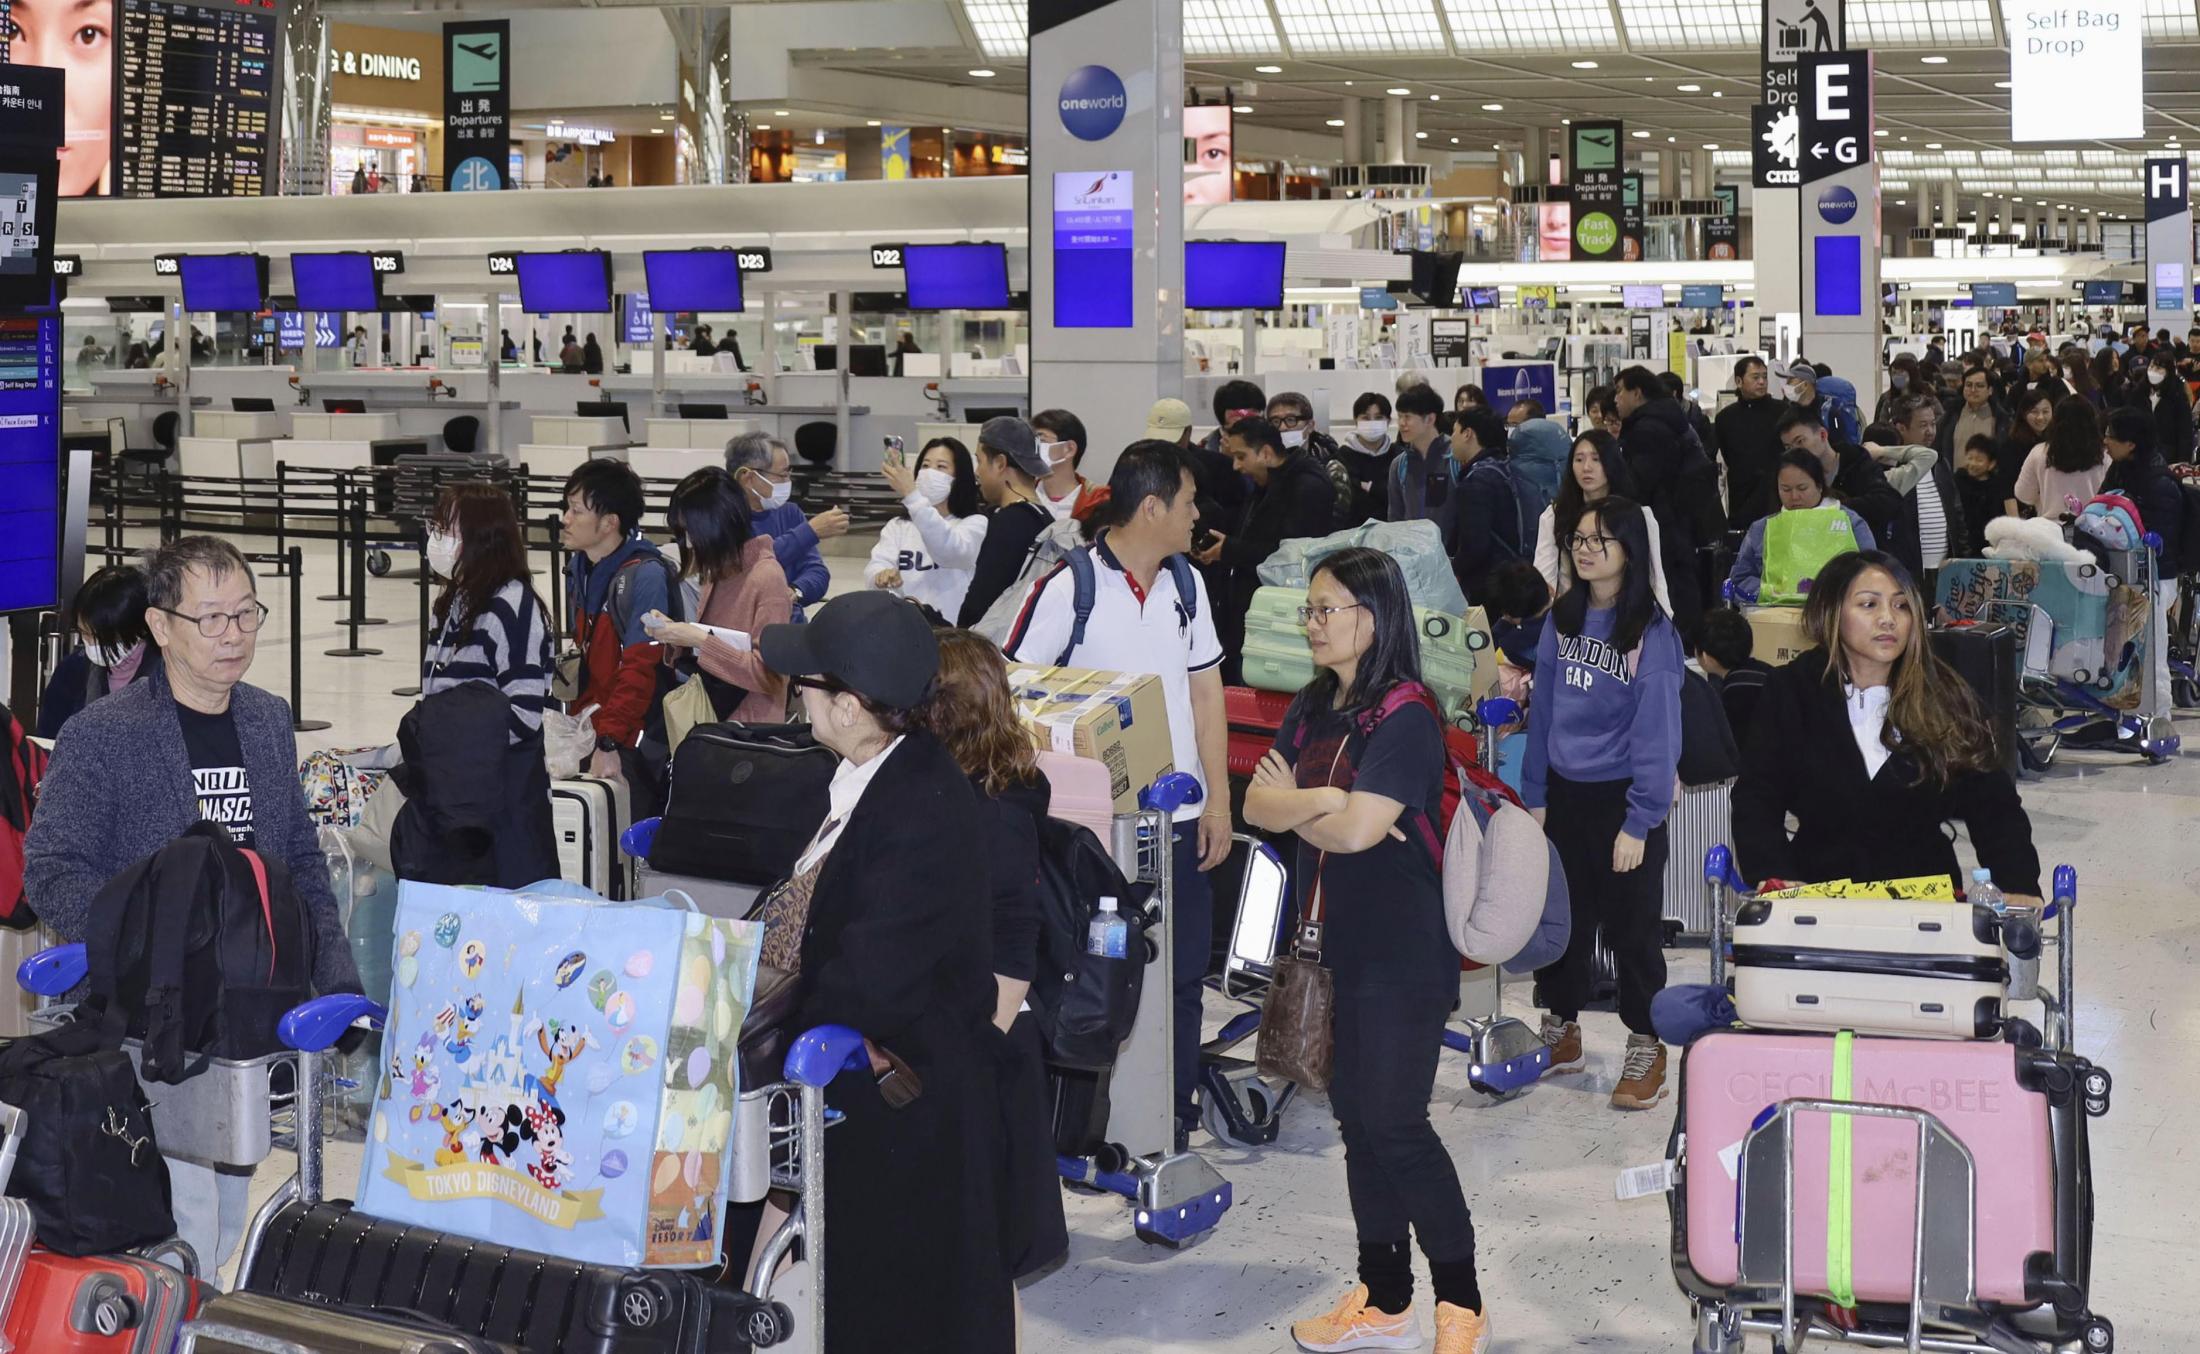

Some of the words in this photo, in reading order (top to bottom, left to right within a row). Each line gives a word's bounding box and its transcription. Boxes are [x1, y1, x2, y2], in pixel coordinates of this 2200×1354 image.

[2026, 9, 2068, 30] Self
[2077, 10, 2119, 31] Bag
[2028, 37, 2084, 57] Drop
[343, 51, 356, 74] &
[361, 53, 420, 80] DINING
[1767, 90, 1798, 105] Dro
[1815, 64, 1850, 121] E
[1061, 95, 1124, 110] oneworld
[450, 115, 502, 126] Departures
[1835, 137, 1857, 163] G
[2152, 165, 2180, 198] H
[1575, 183, 1617, 195] Departures
[19, 201, 25, 212] T
[1819, 200, 1856, 209] oneworld
[5, 224, 12, 234] R
[25, 224, 31, 234] S
[1584, 219, 1609, 230] Fast
[1580, 234, 1612, 246] Track
[373, 257, 397, 270] D25
[738, 254, 764, 269] D23
[873, 250, 900, 265] D22
[54, 260, 74, 274] D27
[156, 259, 177, 272] D26
[490, 258, 514, 271] D24
[45, 320, 50, 329] L
[45, 331, 50, 341] L
[25, 381, 37, 390] Drop
[4, 417, 16, 426] Face
[17, 416, 37, 426] Express
[44, 415, 49, 424] K
[898, 550, 939, 571] BL
[1566, 666, 1593, 692] GAP
[202, 797, 253, 823] NASC
[426, 1170, 471, 1197] TOKYO
[477, 1171, 561, 1221] DISNEYLAND
